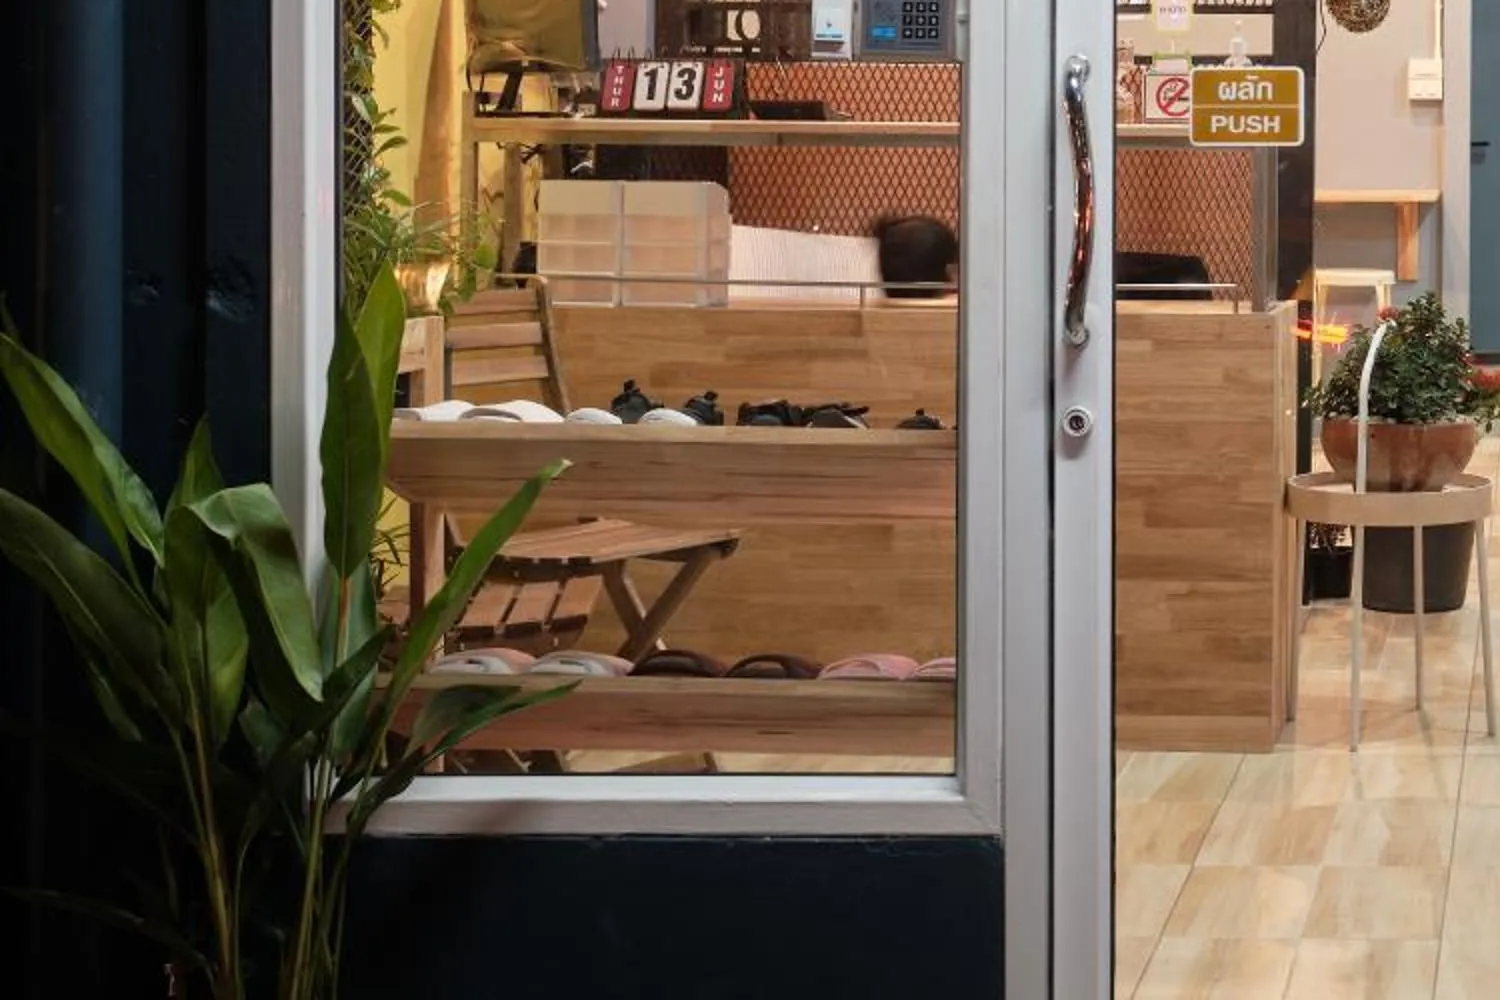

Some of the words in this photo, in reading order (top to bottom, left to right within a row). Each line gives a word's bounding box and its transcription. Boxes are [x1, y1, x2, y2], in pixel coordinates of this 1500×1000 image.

[610, 65, 625, 108] THUR
[711, 65, 724, 104] JUN
[1217, 74, 1274, 102] ผลัก
[1210, 114, 1281, 134] PUSH
